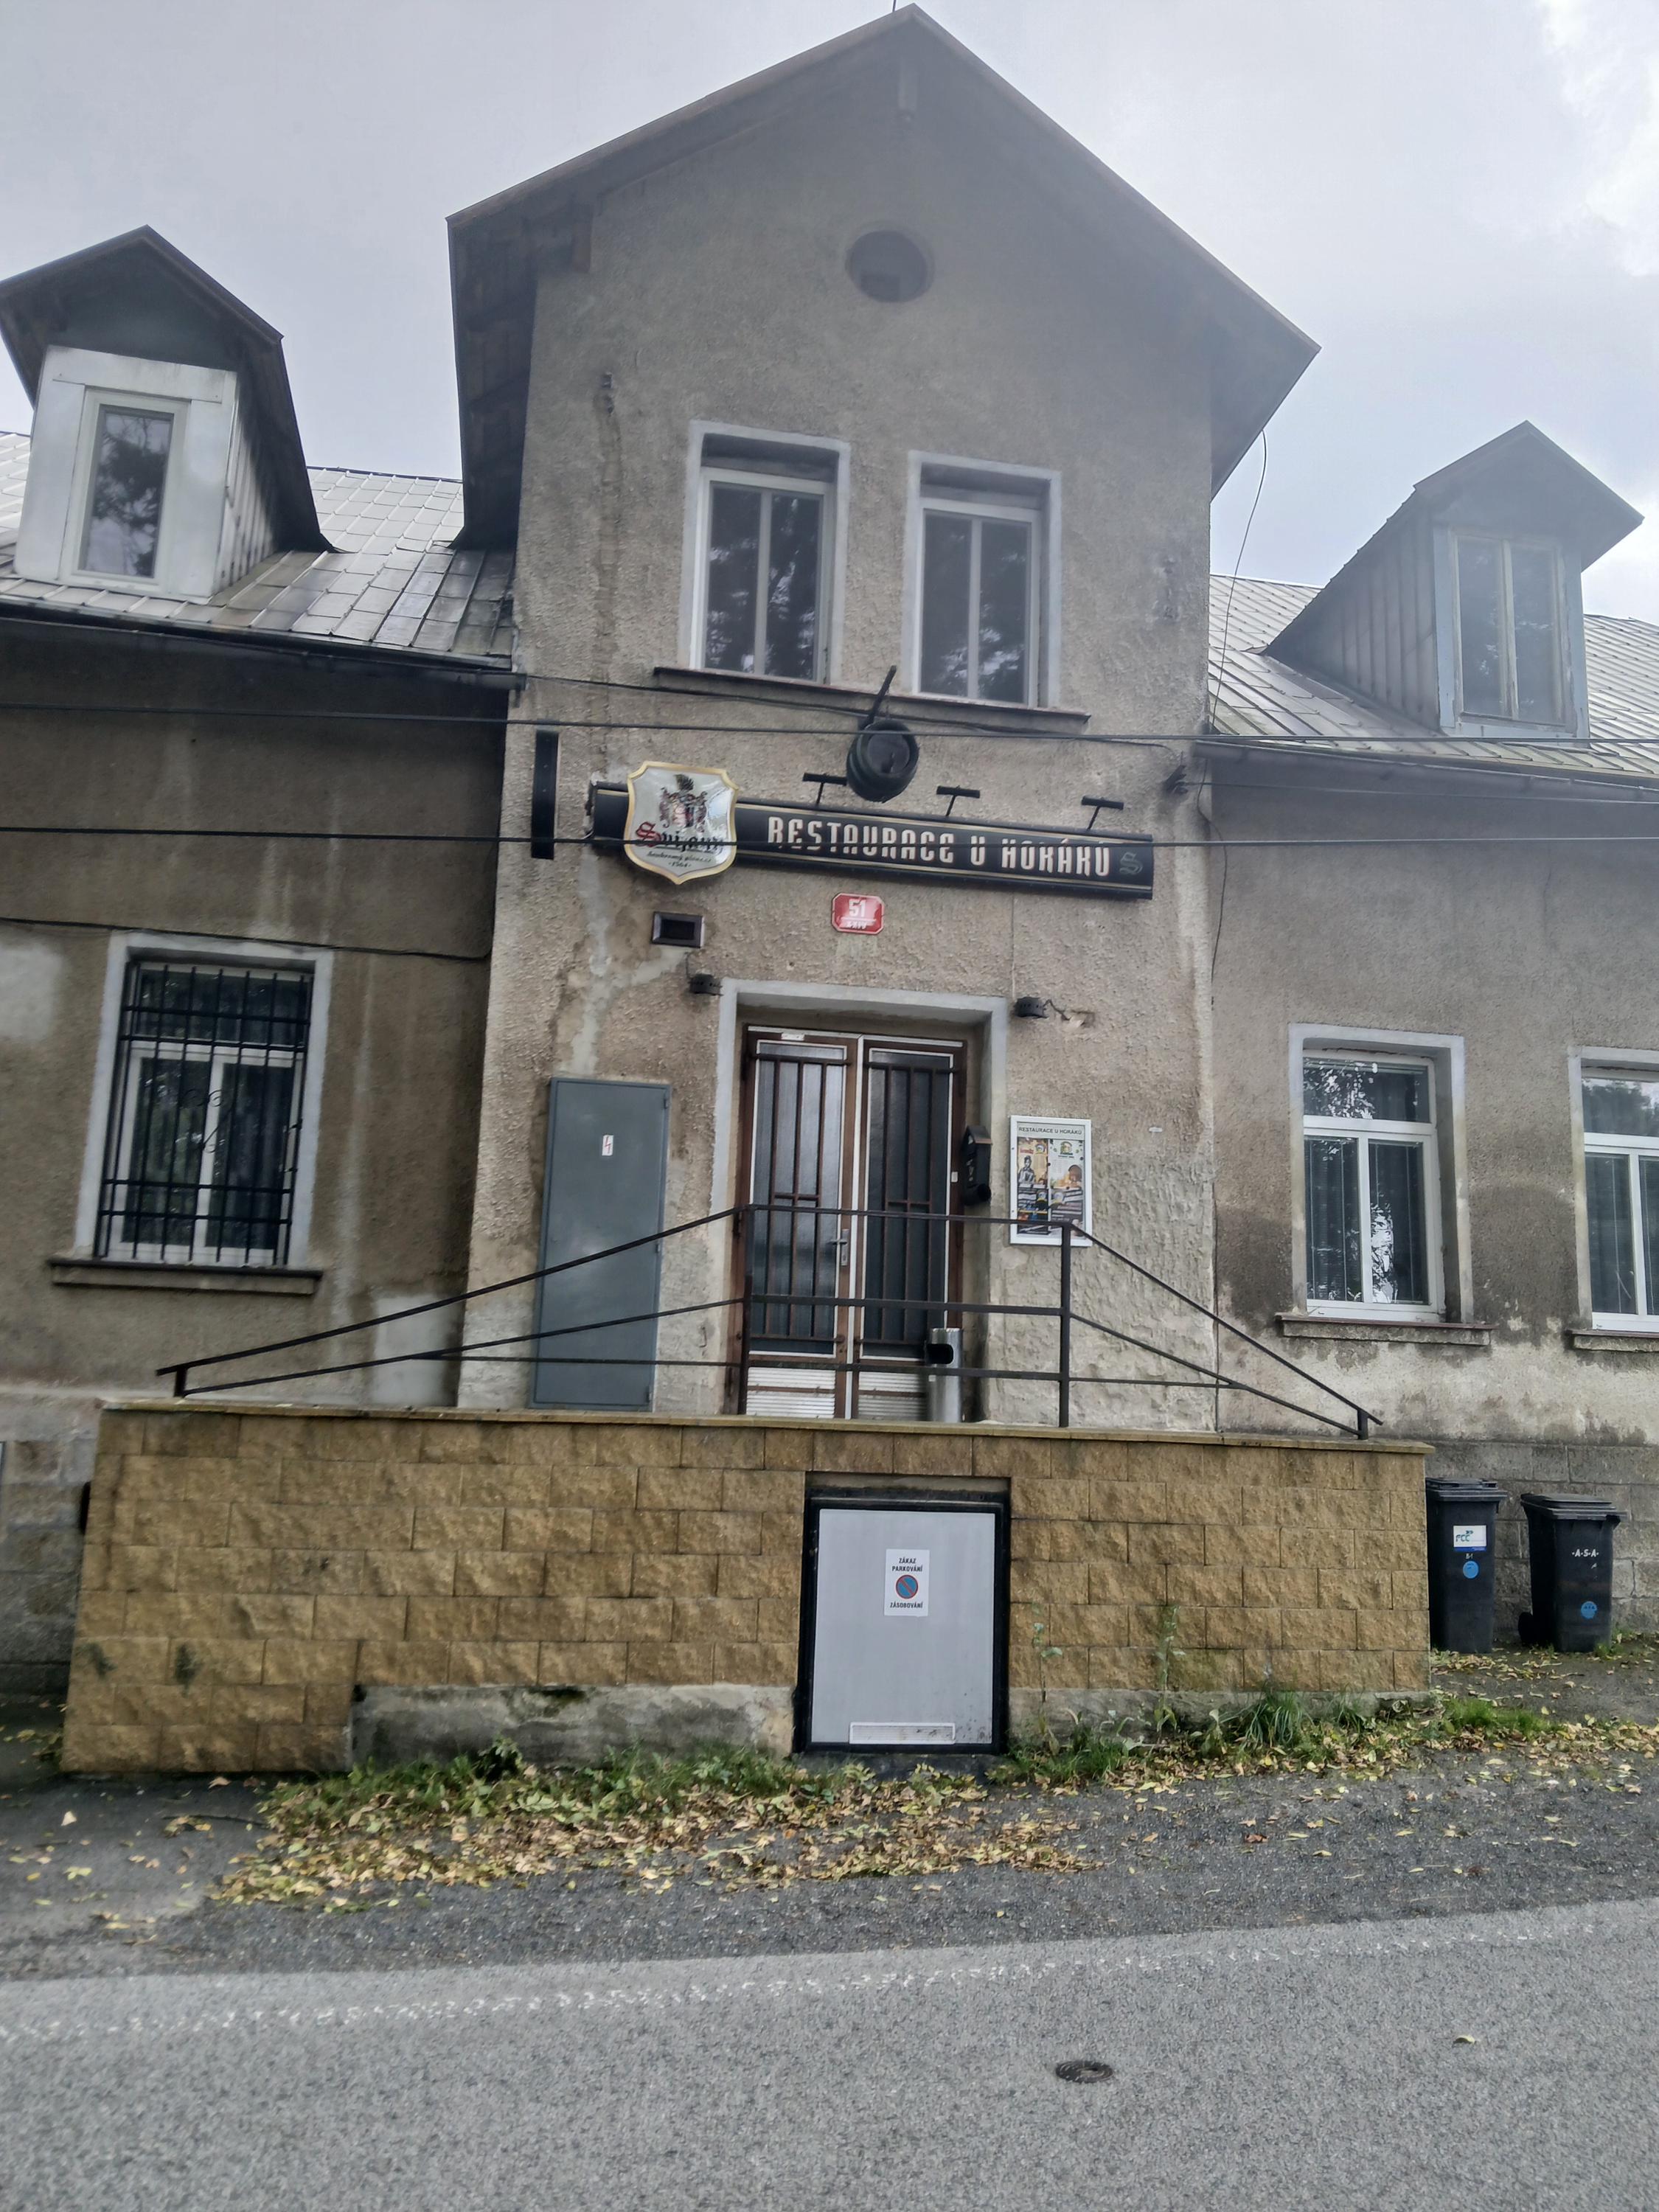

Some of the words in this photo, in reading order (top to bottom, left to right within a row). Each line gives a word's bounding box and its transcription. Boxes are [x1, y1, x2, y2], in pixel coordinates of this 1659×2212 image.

[768, 816, 955, 863] RESTAURACE
[970, 835, 986, 866] U
[849, 898, 866, 917] 51
[1455, 1534, 1470, 1543] FCC
